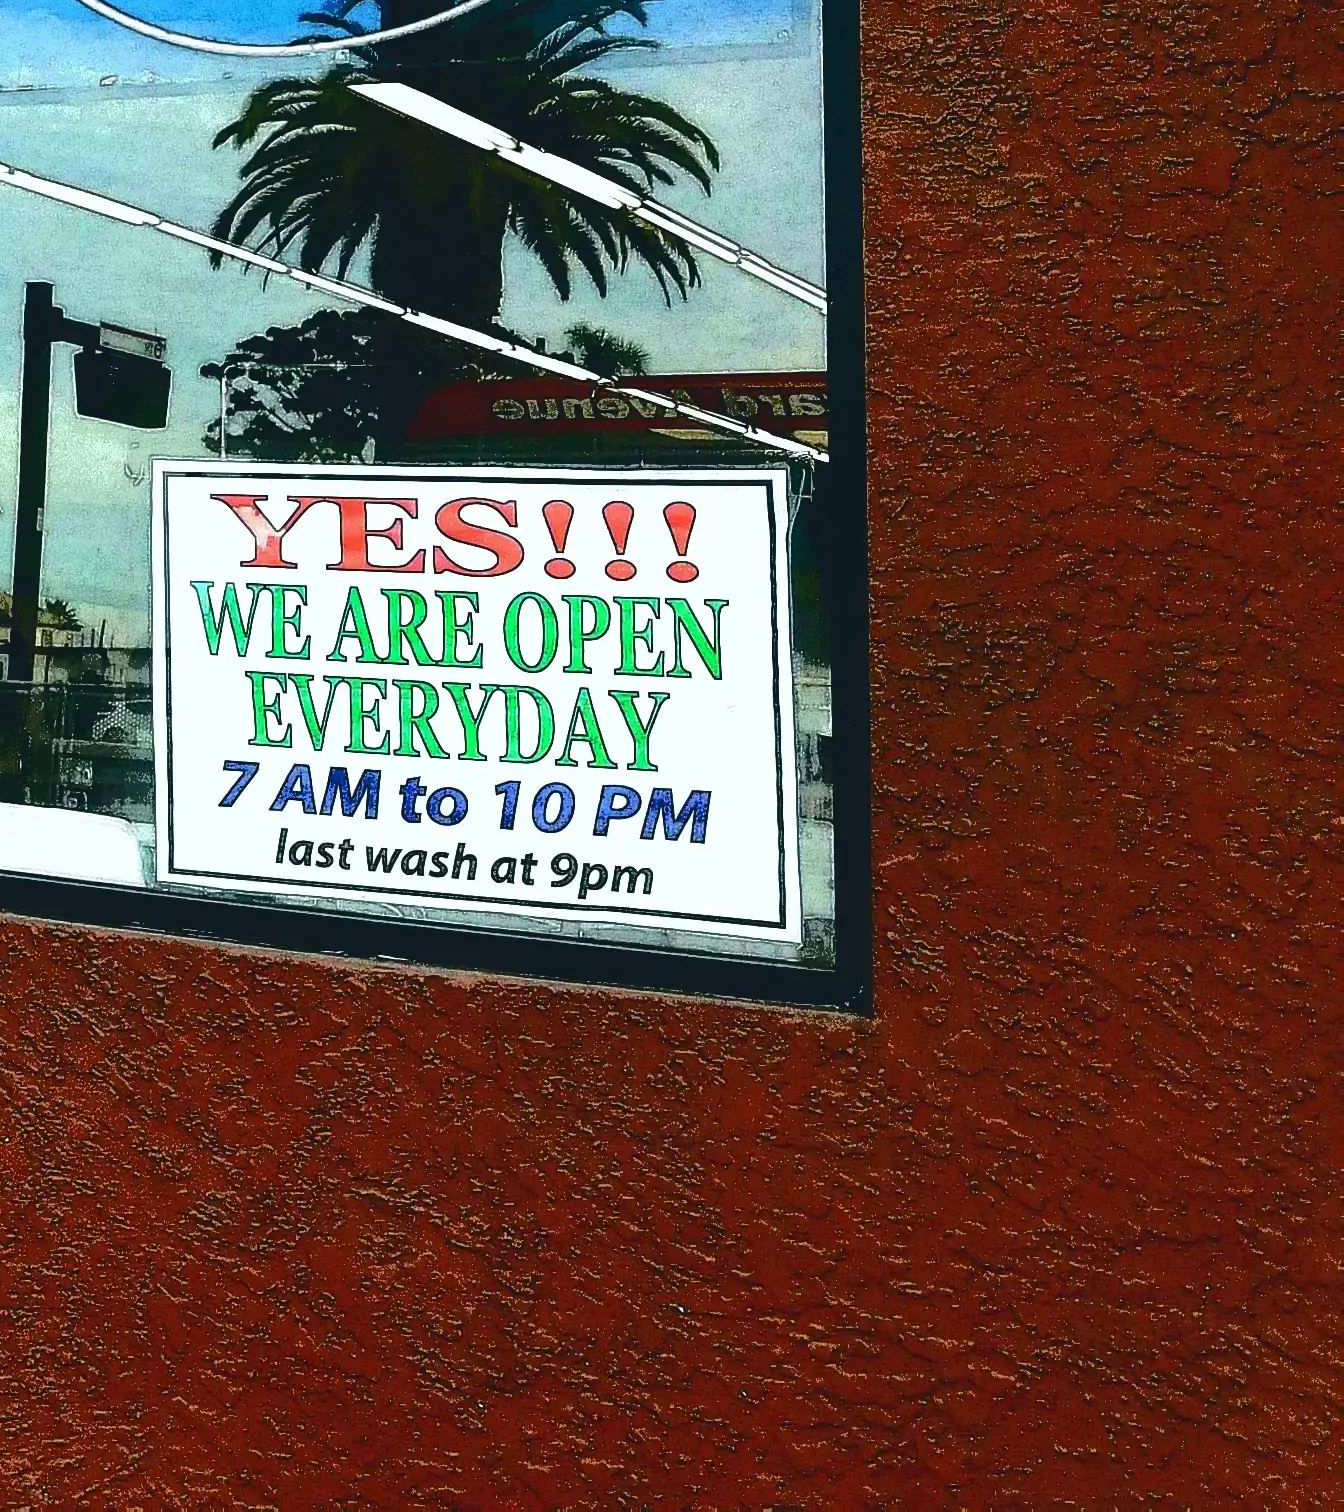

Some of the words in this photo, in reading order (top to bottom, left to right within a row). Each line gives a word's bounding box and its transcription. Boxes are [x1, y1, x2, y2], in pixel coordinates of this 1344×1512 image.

[208, 492, 701, 583] YES!!!
[189, 578, 311, 663] WE
[325, 584, 485, 670] ARE
[502, 590, 730, 682] OPEN
[243, 668, 671, 772] EVERYDAY
[218, 759, 260, 810] 7
[268, 762, 384, 822] AM
[398, 774, 470, 828] to
[494, 779, 576, 835] 10
[592, 785, 712, 845] PM
[273, 826, 355, 873] last
[363, 836, 479, 883] wash
[489, 851, 540, 887] at
[549, 852, 656, 900] 9pm
